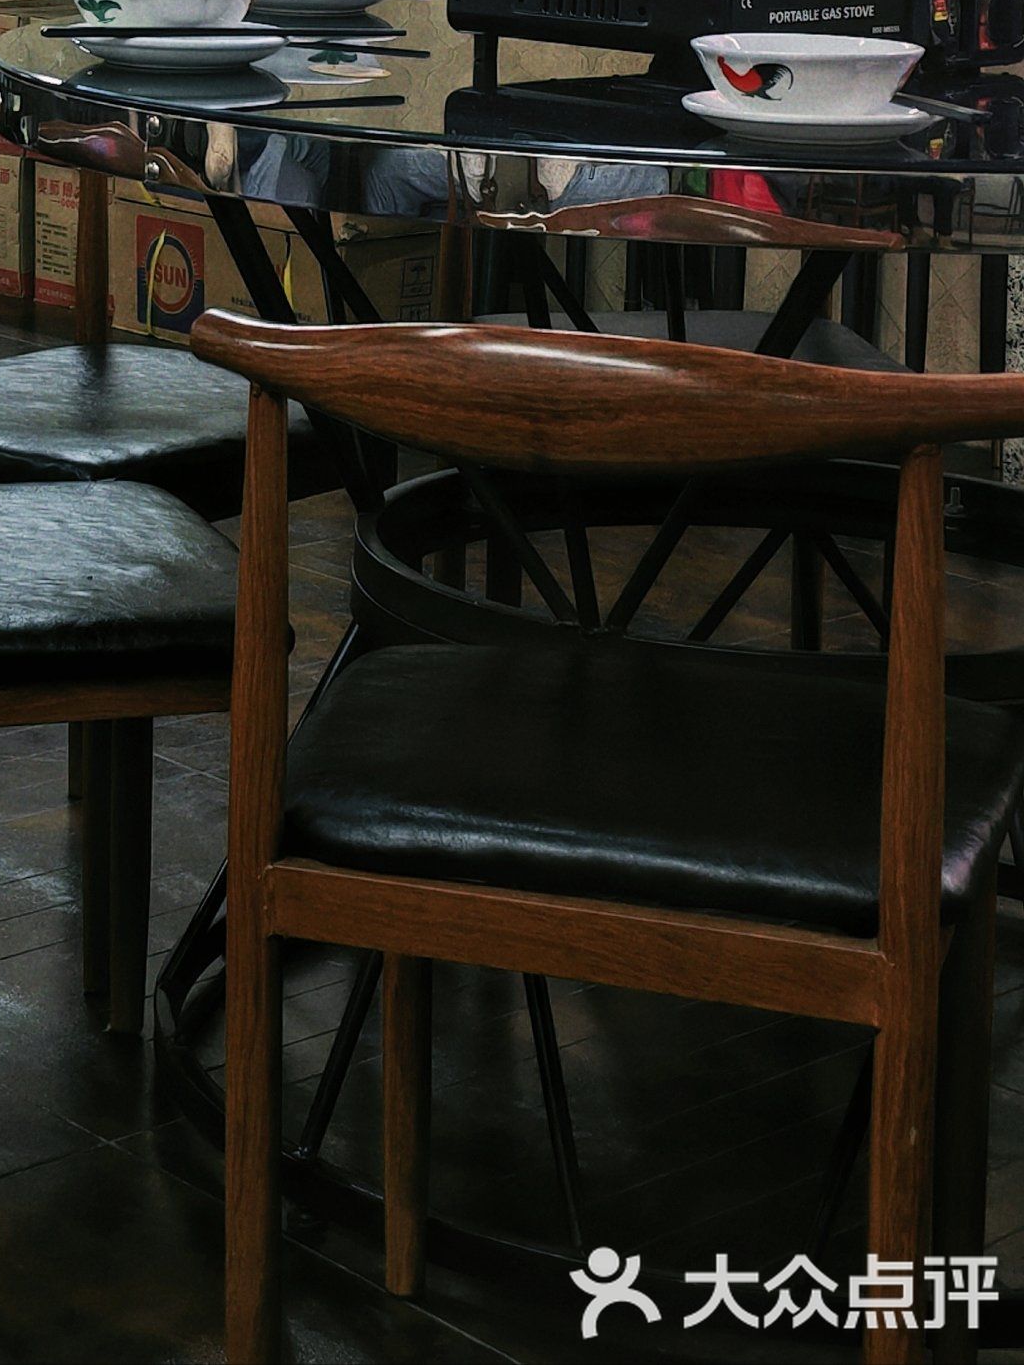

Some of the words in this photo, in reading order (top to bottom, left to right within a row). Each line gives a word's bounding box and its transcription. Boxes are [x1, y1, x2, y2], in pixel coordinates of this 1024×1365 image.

[769, 8, 820, 24] PORTABLE
[821, 6, 843, 21] GAS
[843, 5, 875, 18] STOVE
[155, 264, 187, 288] SUN
